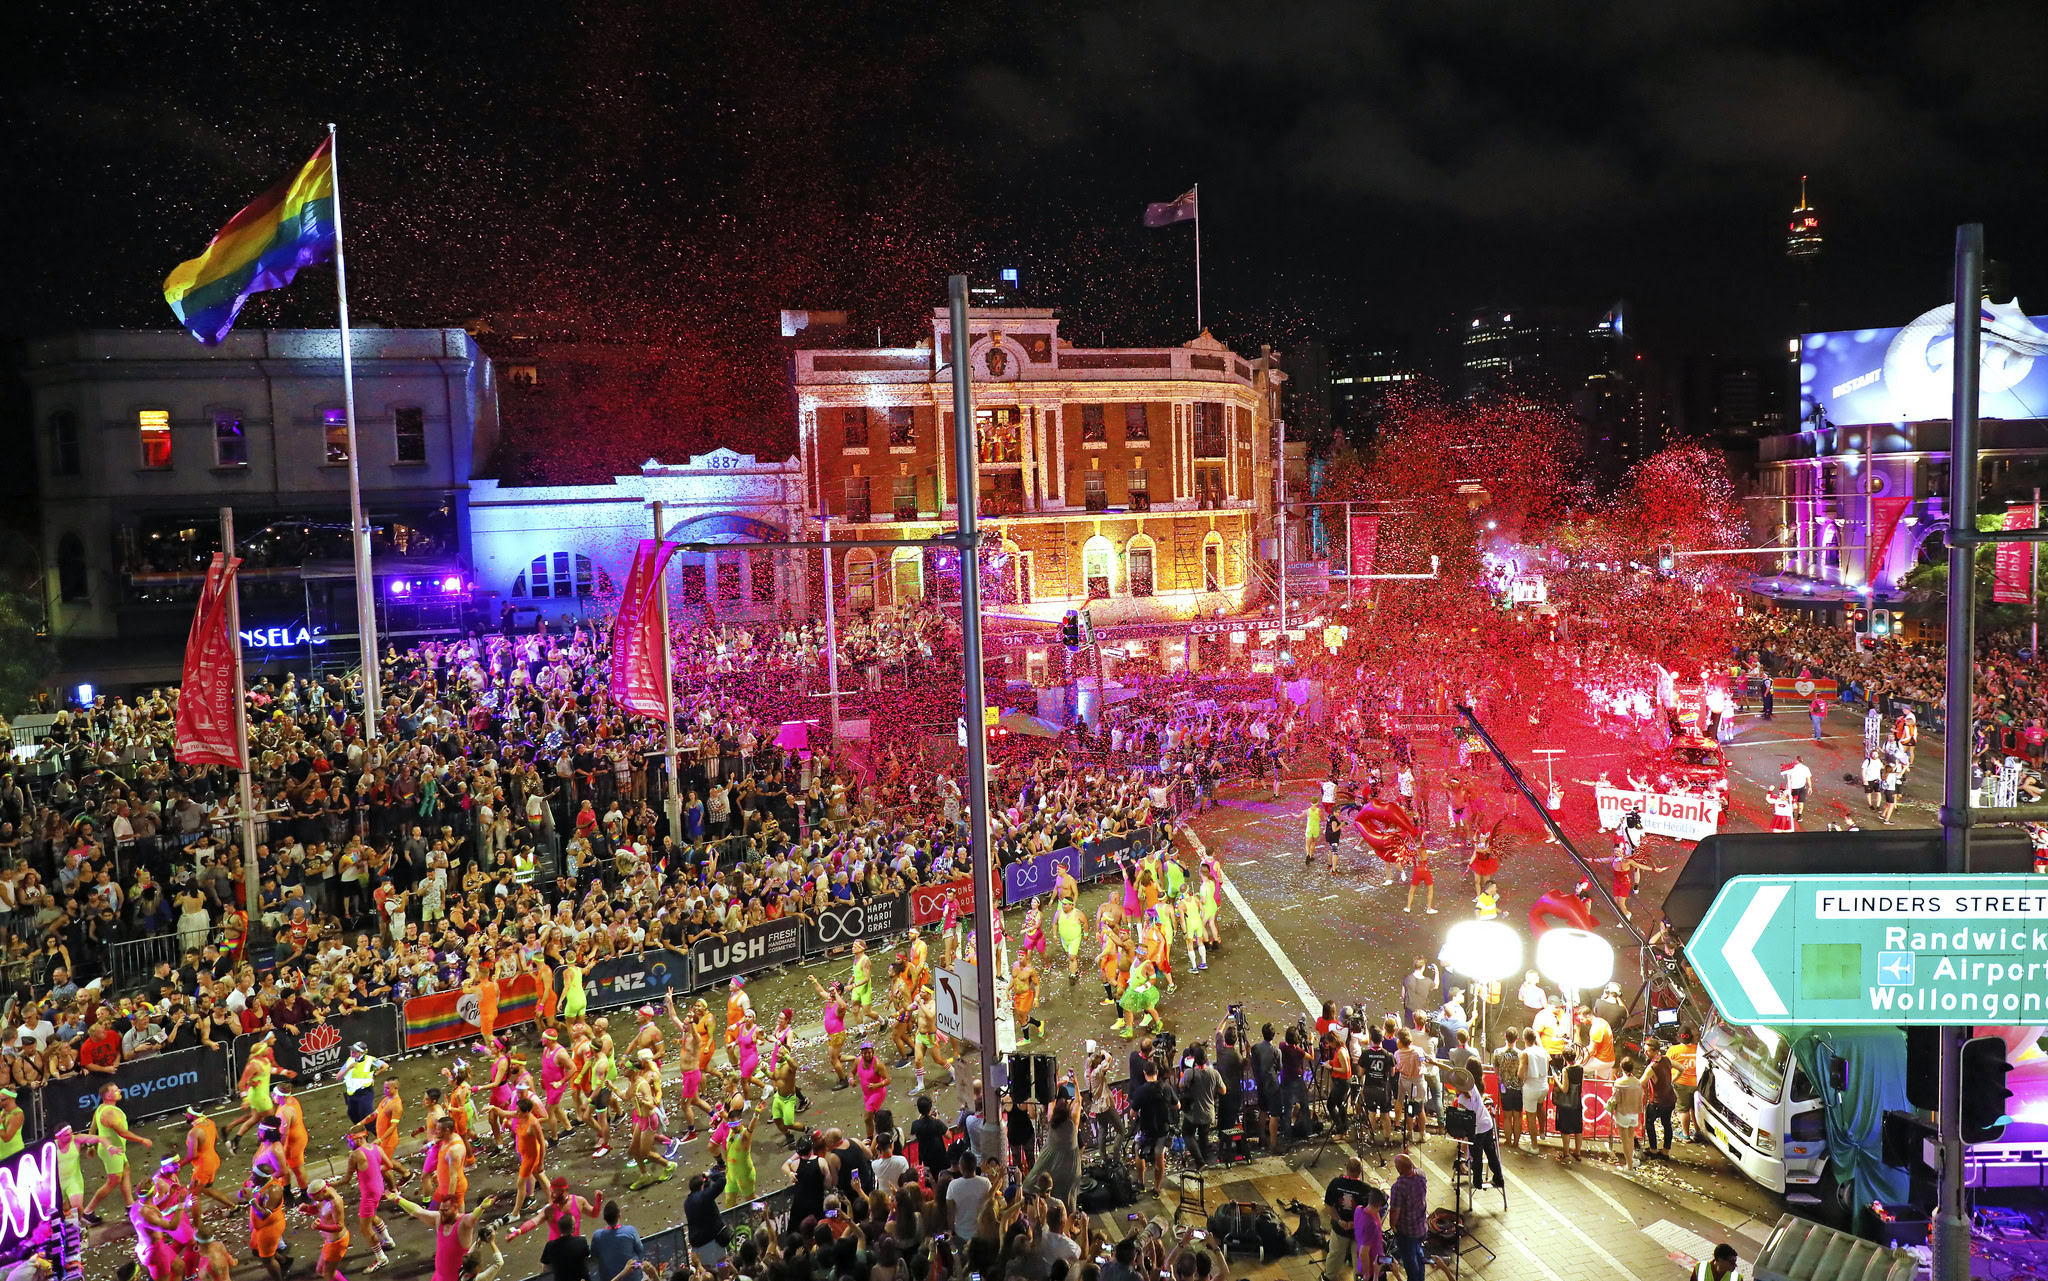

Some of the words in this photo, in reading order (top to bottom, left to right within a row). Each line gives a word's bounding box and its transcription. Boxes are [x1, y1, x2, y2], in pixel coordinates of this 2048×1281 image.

[616, 624, 626, 639] OF
[1190, 616, 1304, 634] COURTHOUSE
[614, 641, 625, 670] YEARS
[615, 670, 623, 683] 40
[1600, 794, 1712, 823] medibank
[1663, 821, 1696, 834] Health
[867, 900, 893, 914] HAPPY
[1823, 897, 1941, 912] FLINDERS
[1955, 897, 2046, 912] STREET
[867, 910, 892, 923] MARDI
[867, 919, 891, 933] GRAS!
[768, 927, 797, 942] FRESH
[768, 936, 796, 948] HANDMADE
[1885, 926, 2048, 950] Randwick
[698, 935, 765, 974] LUSH
[768, 942, 796, 954] COSMETICS
[938, 1013, 960, 1032] ONLY
[301, 1046, 341, 1069] NSW
[302, 1058, 341, 1075] GOVERNMENT
[1370, 1060, 1384, 1071] 40
[78, 1070, 198, 1110] syney.com
